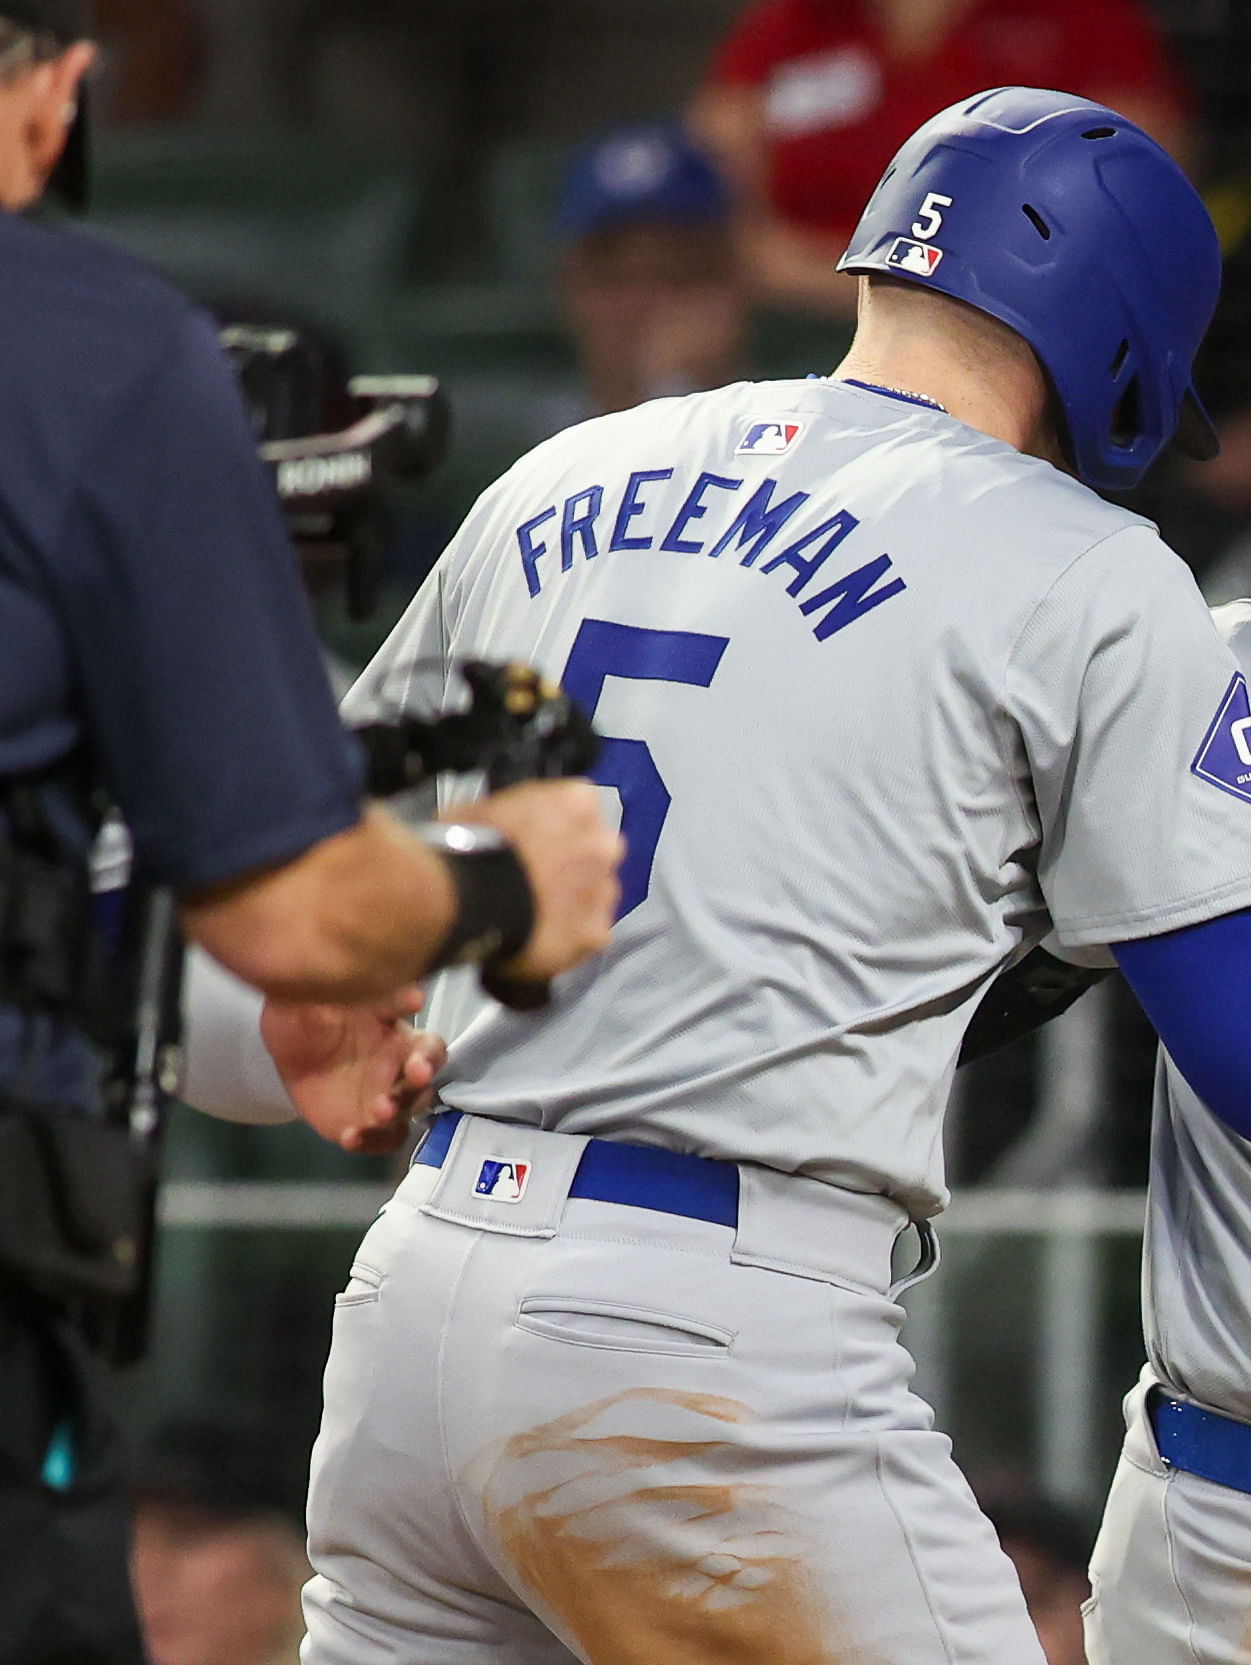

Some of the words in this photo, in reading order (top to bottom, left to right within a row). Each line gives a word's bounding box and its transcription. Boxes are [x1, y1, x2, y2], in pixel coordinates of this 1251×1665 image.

[911, 192, 953, 241] 5
[516, 467, 907, 642] FREEMAN
[560, 618, 730, 929] 5
